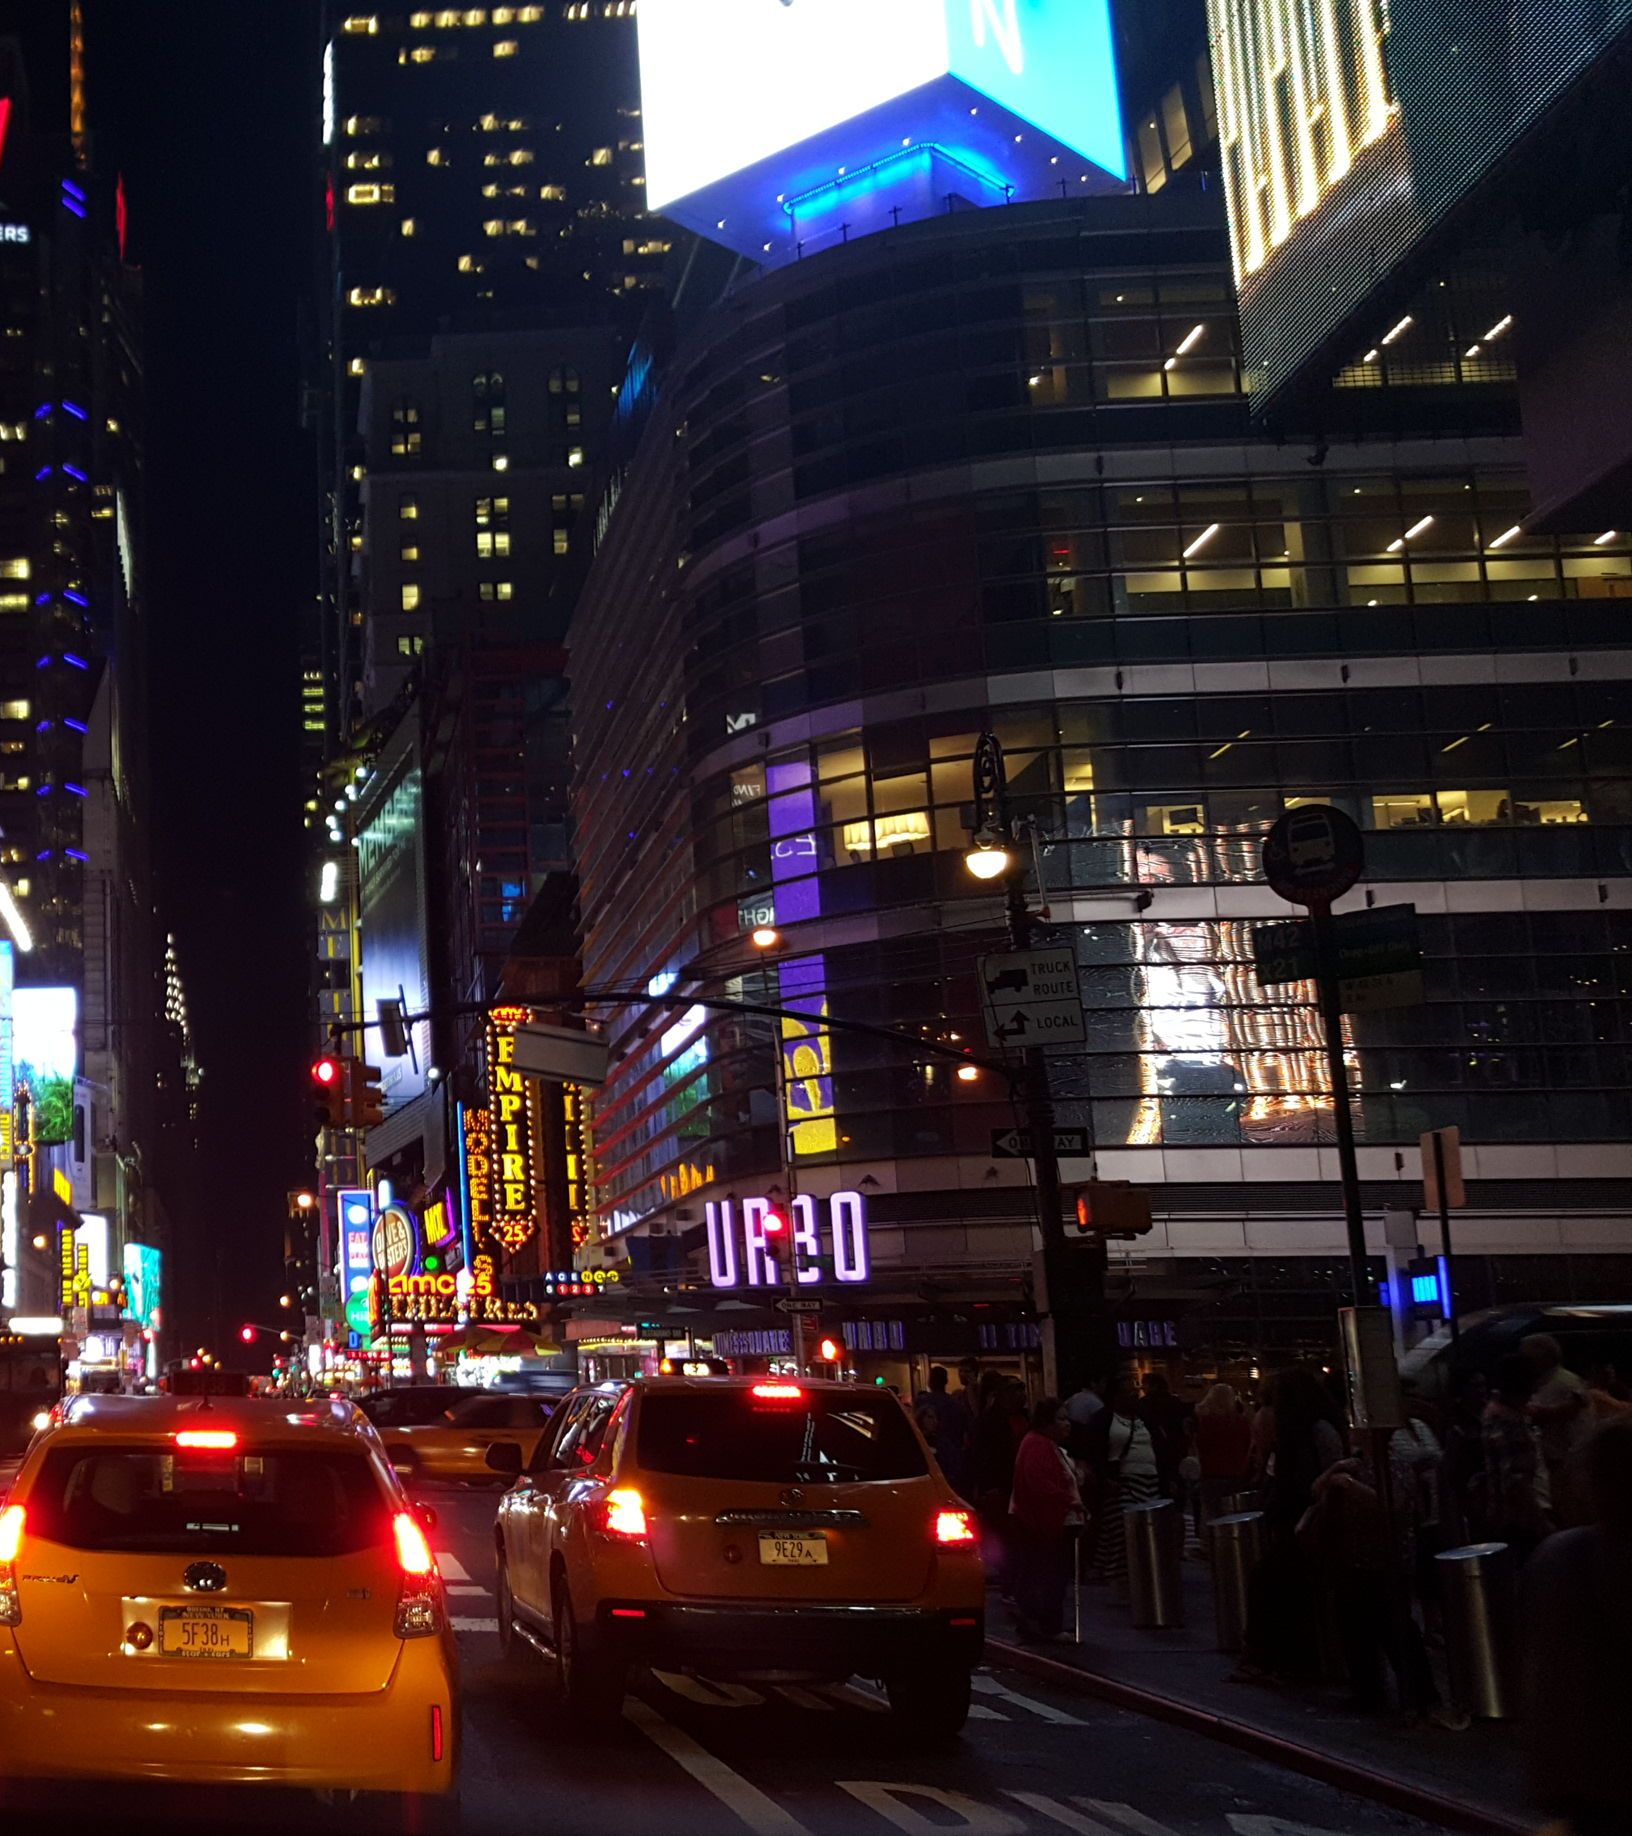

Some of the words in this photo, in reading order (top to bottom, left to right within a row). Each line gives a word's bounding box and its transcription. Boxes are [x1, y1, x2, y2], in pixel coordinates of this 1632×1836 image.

[1030, 961, 1070, 975] TRUCK
[1033, 981, 1074, 996] ROUTE
[1037, 1015, 1078, 1029] LOCAL
[494, 1035, 526, 1211] EMPIRE
[376, 1221, 398, 1250] DVE
[503, 1225, 524, 1242] 25
[705, 1190, 867, 1288] URBO
[378, 1239, 408, 1269] BSTERS
[388, 1274, 456, 1294] amc
